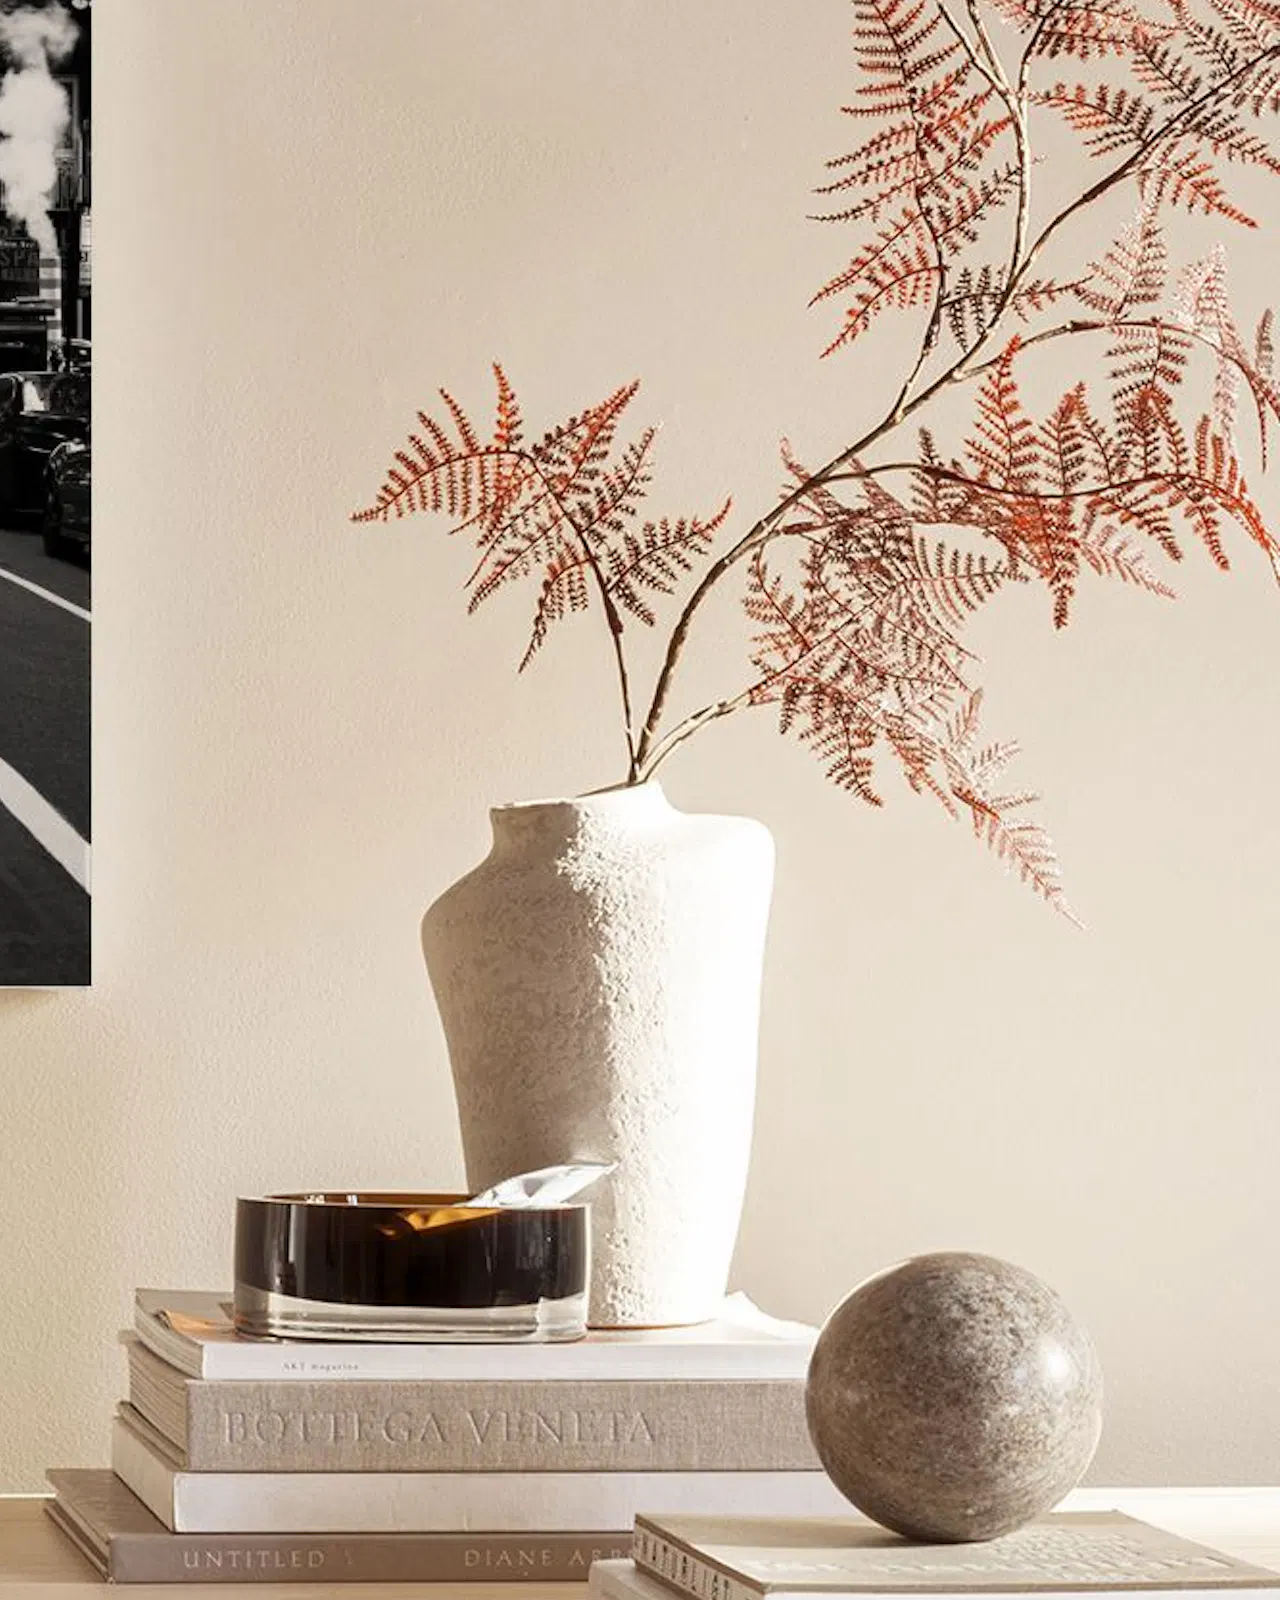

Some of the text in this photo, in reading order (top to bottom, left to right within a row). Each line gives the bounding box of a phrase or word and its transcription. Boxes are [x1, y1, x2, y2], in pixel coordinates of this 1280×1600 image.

[222, 1409, 657, 1446] BOTTEGA VENETA
[183, 1549, 326, 1569] UNTITLED
[464, 1549, 553, 1568] DIANE
